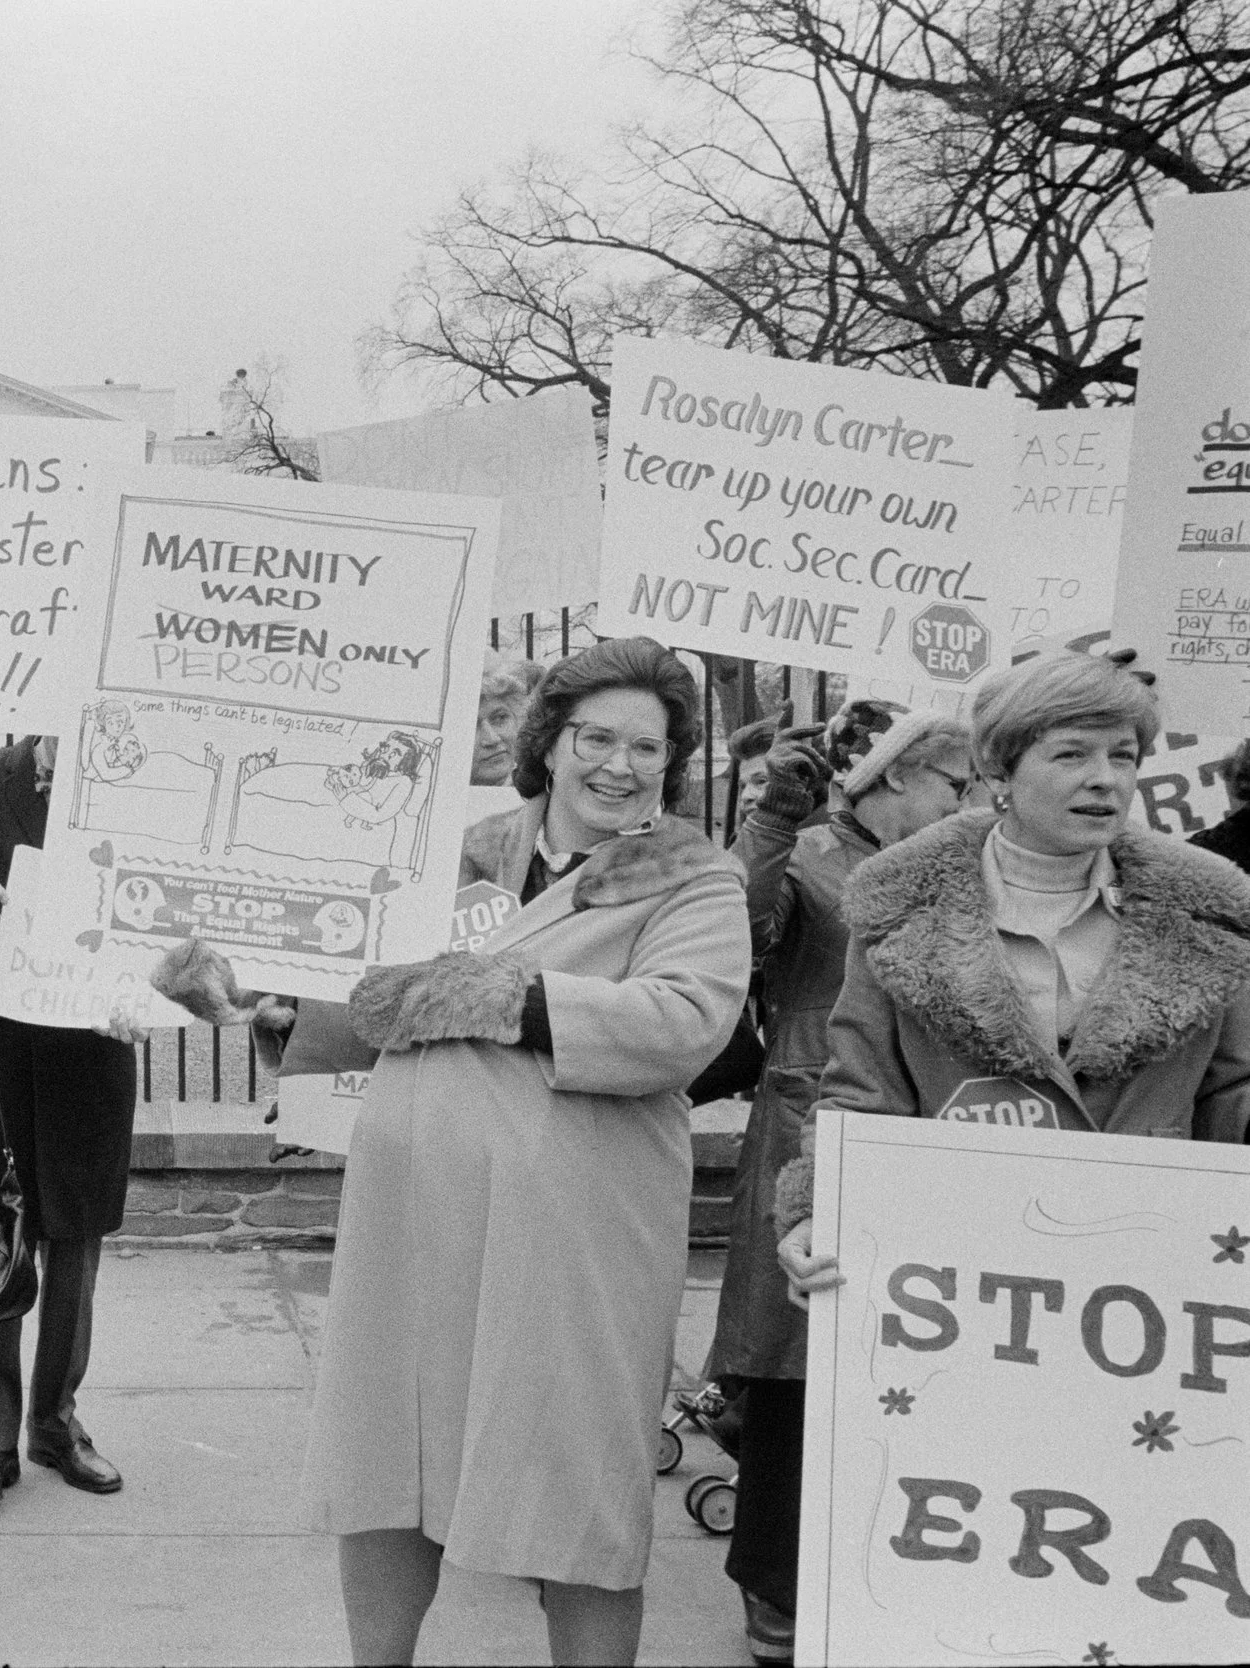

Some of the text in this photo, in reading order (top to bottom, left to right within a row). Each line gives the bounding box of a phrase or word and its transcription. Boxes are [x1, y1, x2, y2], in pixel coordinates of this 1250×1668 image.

[640, 375, 804, 448] Rosalyn
[1013, 431, 1107, 472] ASE,
[623, 441, 716, 492] tear
[722, 466, 772, 512] up
[779, 475, 873, 519] your
[879, 492, 959, 534] own
[1012, 484, 1128, 517] ARTE
[1181, 519, 1245, 549] Equal
[141, 531, 383, 587] MATERNITY
[696, 519, 774, 570] Soc.
[783, 532, 864, 586] Sec.
[200, 580, 323, 611] WARD
[626, 573, 730, 628] NOT
[1179, 588, 1228, 608] ERA
[154, 611, 432, 670] WOMEN ONLY
[914, 617, 984, 653] STOP
[1177, 612, 1250, 638] pay fo
[152, 642, 344, 694] PERSONS
[925, 648, 972, 675] ERA
[133, 700, 166, 714] Some
[170, 699, 211, 723] things
[214, 704, 247, 722] can't
[251, 709, 268, 726] be
[163, 875, 324, 905] You can't fool Mother Nature
[190, 892, 286, 921] STOP
[173, 910, 301, 937] The Equal Rights
[190, 925, 284, 947] Amendment
[879, 1262, 1250, 1395] STOP
[888, 1476, 1250, 1620] ERA
